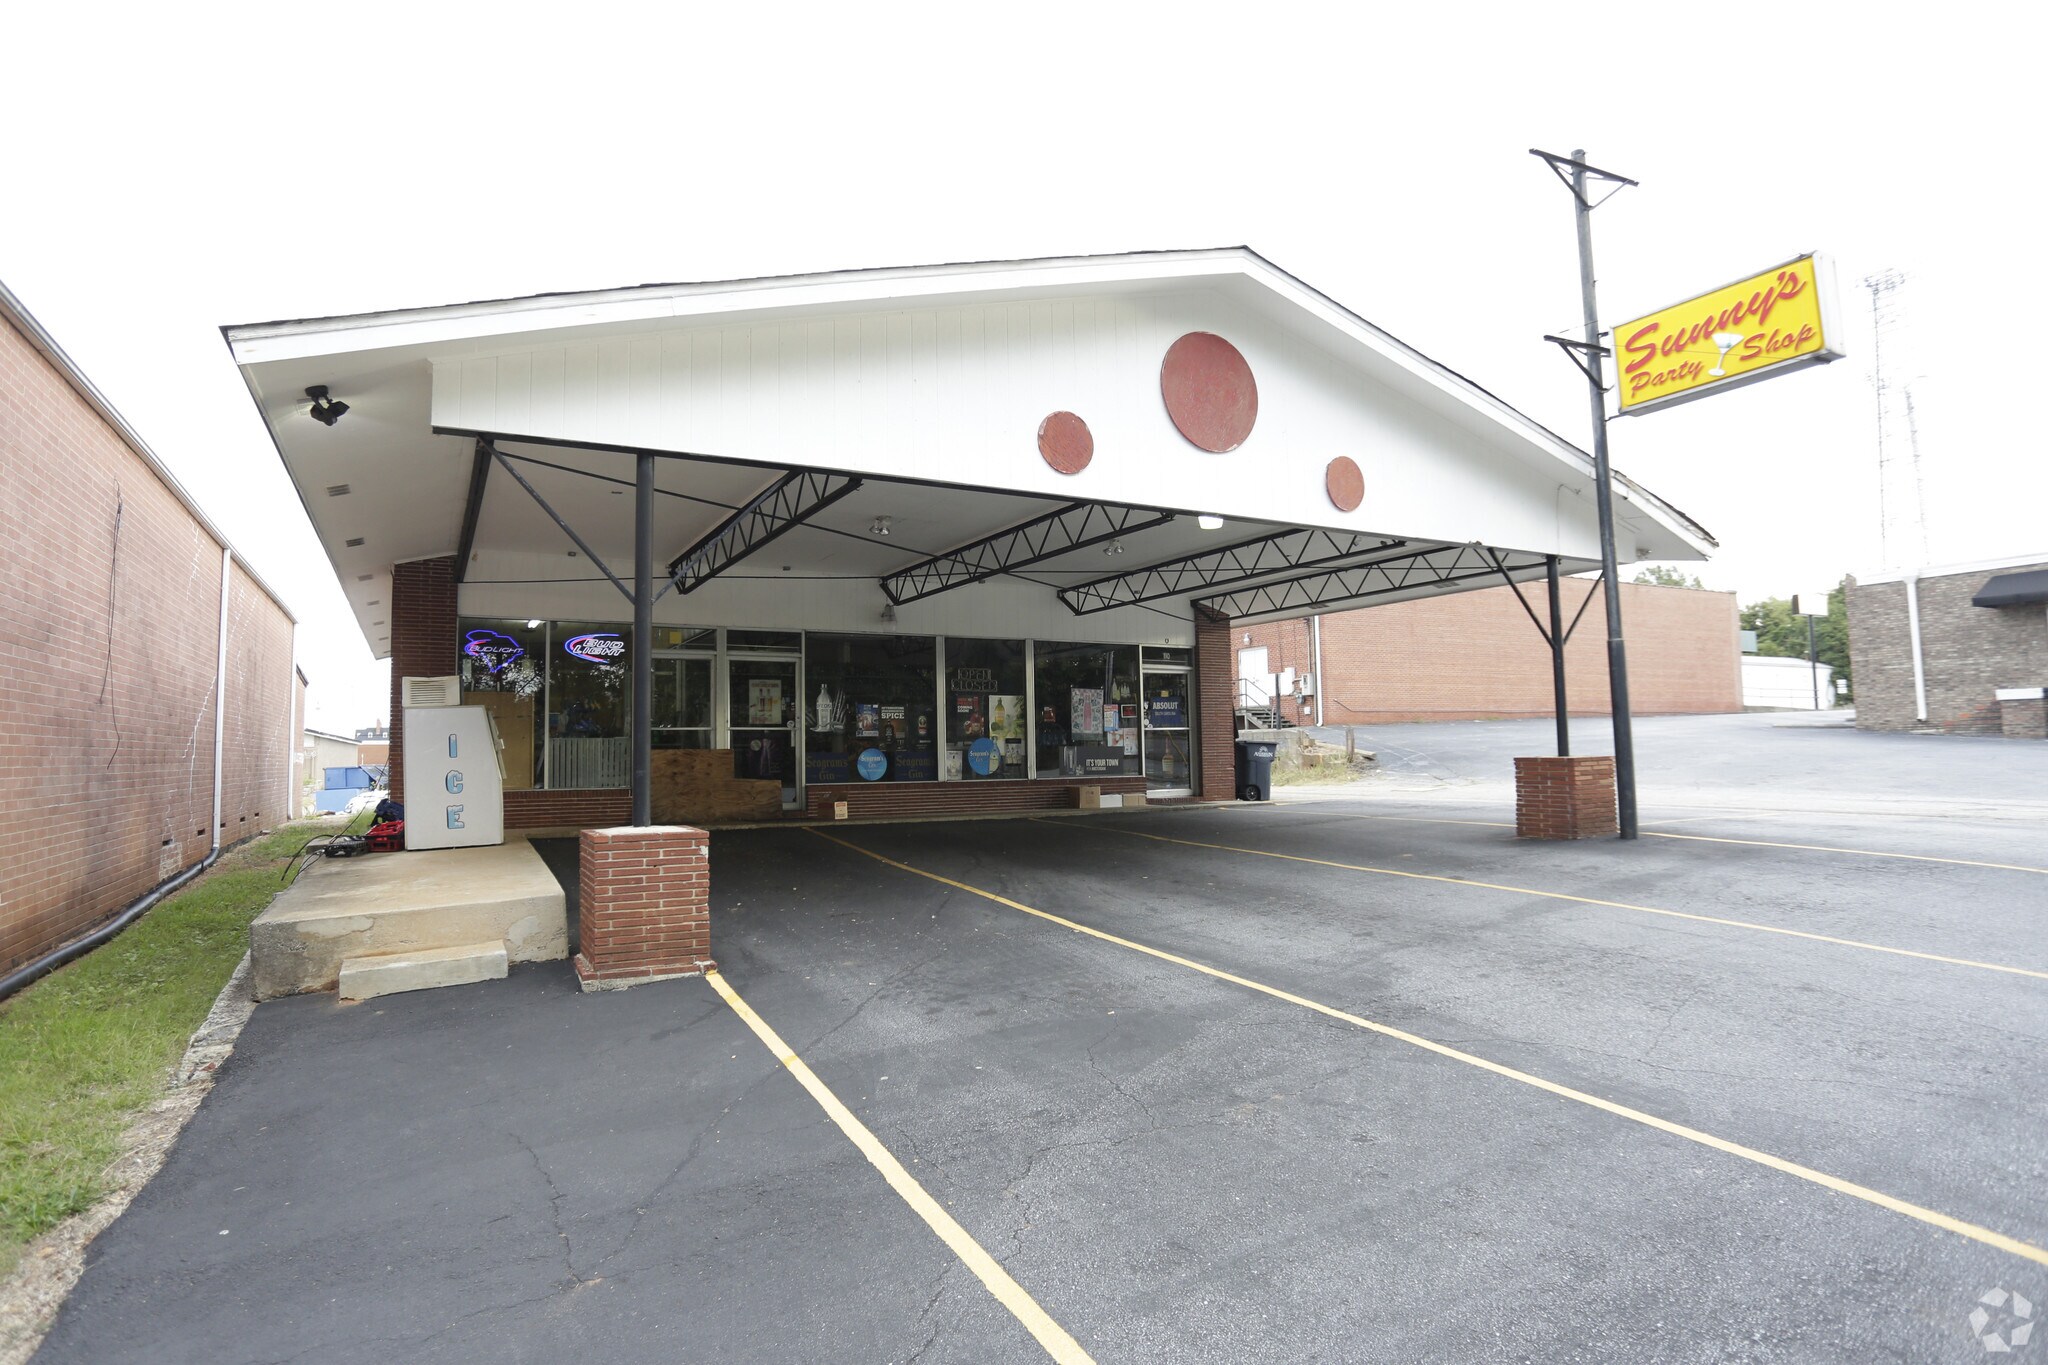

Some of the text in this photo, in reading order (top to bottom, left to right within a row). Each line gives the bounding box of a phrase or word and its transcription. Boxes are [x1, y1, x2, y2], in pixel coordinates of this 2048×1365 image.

[1625, 271, 1806, 374] Sunny's
[1630, 323, 1817, 399] Party Shop
[583, 638, 624, 649] BUD
[492, 646, 524, 654] LIGHT
[573, 645, 625, 656] LIGHT
[1152, 702, 1178, 710] ABSOLUT
